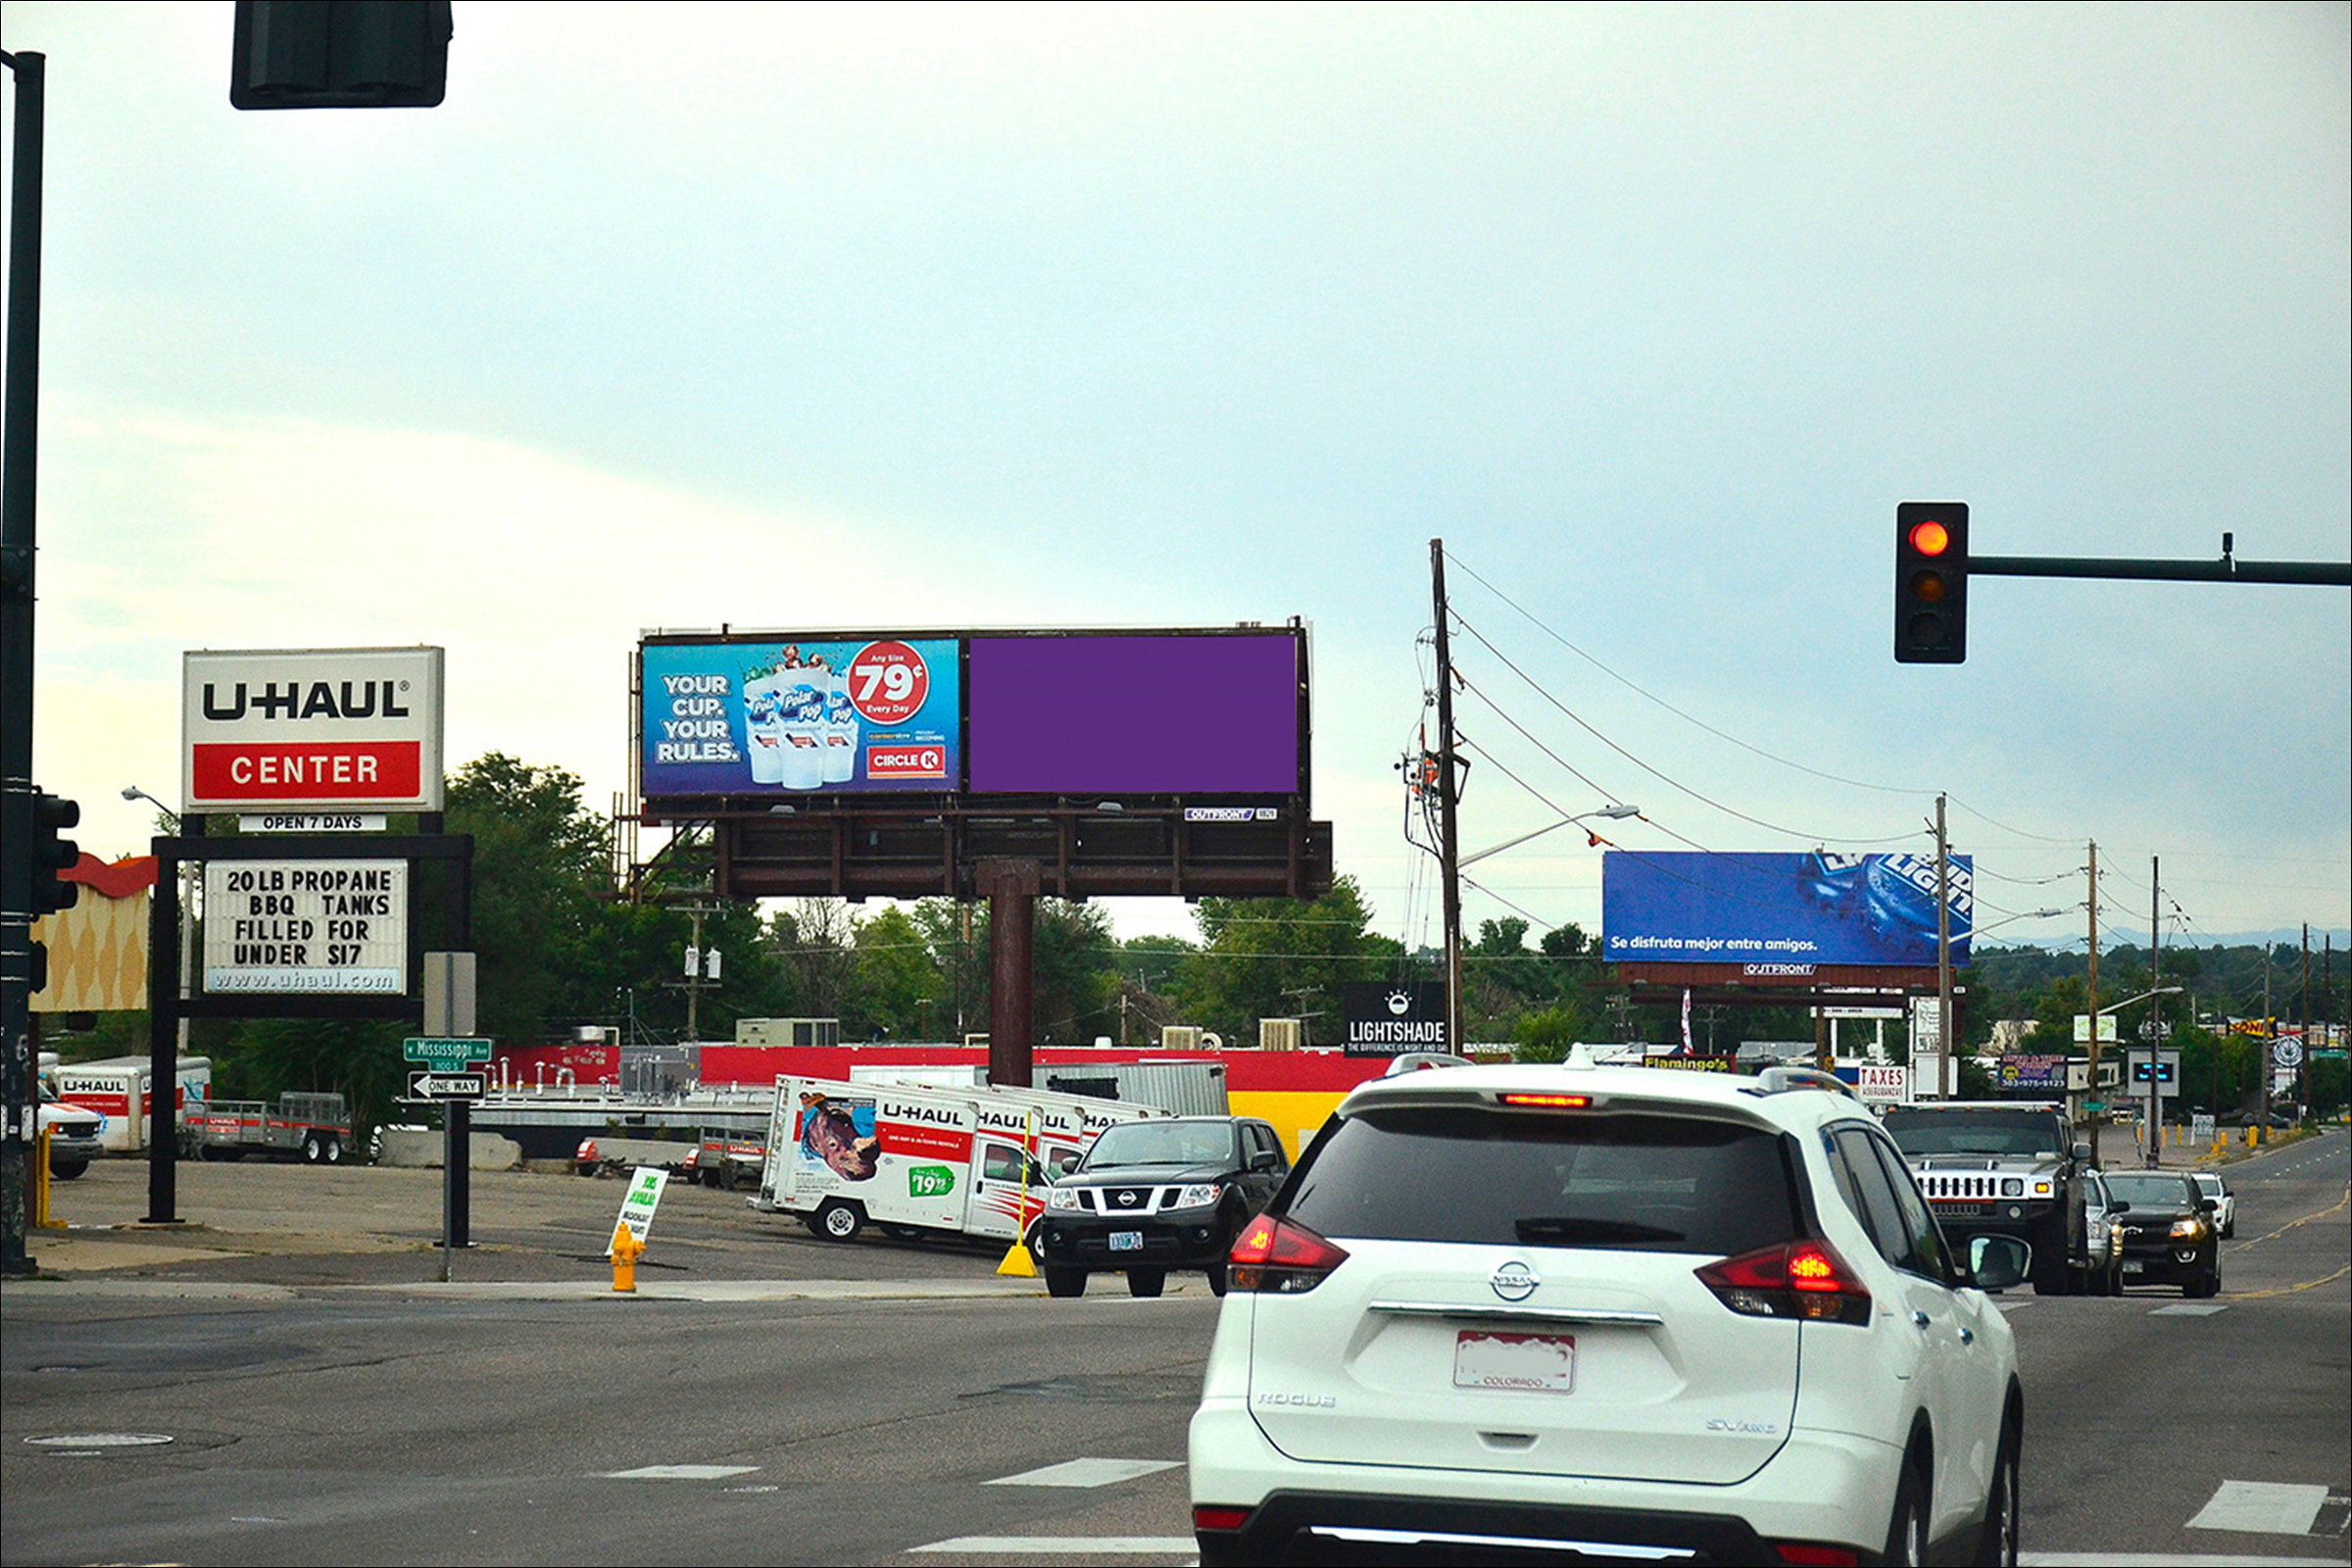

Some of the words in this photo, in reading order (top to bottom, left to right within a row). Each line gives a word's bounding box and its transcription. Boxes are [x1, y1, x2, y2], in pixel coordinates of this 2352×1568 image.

[662, 675, 728, 695] YOUR
[203, 680, 410, 720] U-HAUL
[672, 698, 724, 716] CUP.
[785, 689, 814, 709] Polar
[866, 705, 891, 713] Every
[893, 705, 910, 714] Day
[662, 719, 728, 739] YOUR
[658, 742, 739, 761] RULES.
[230, 755, 378, 784] CENTER
[873, 755, 919, 767] CIRCLE
[263, 816, 307, 829] OPEN
[309, 816, 318, 829] 7
[322, 815, 363, 829] DAYS
[227, 871, 254, 892] 20
[258, 871, 284, 892] LB
[291, 871, 391, 892] PROPANE
[250, 895, 294, 915] BBQ
[321, 895, 390, 915] TANKS
[235, 920, 314, 941] FILLED
[328, 920, 369, 941] FOR
[234, 944, 308, 964] UNDER
[1610, 936, 1628, 949] Se
[1630, 936, 1683, 950] disfruta
[1685, 937, 1725, 952] mejor
[1727, 939, 1763, 951] entre
[1765, 938, 1818, 954] amigos.
[1746, 963, 1812, 974] OUTFRONT
[215, 971, 394, 989] www.uhaul.com
[1349, 1021, 1445, 1042] LIGHTSHADE
[2231, 1022, 2274, 1038] SONI
[416, 1041, 472, 1059] Mississippi
[1645, 1057, 1728, 1071] Flamingo's
[64, 1080, 124, 1092] U-HAUL
[1861, 1068, 1904, 1086] TAXES
[428, 1081, 450, 1092] ONE
[454, 1081, 476, 1092] WAY
[883, 1103, 963, 1126] U-HAUL
[1494, 1275, 1536, 1285] NISSAN
[1483, 1375, 1544, 1389] COLORADO
[1257, 1392, 1337, 1409] ROGUE
[1706, 1418, 1742, 1432] SV
[1740, 1423, 1777, 1435] AWD
